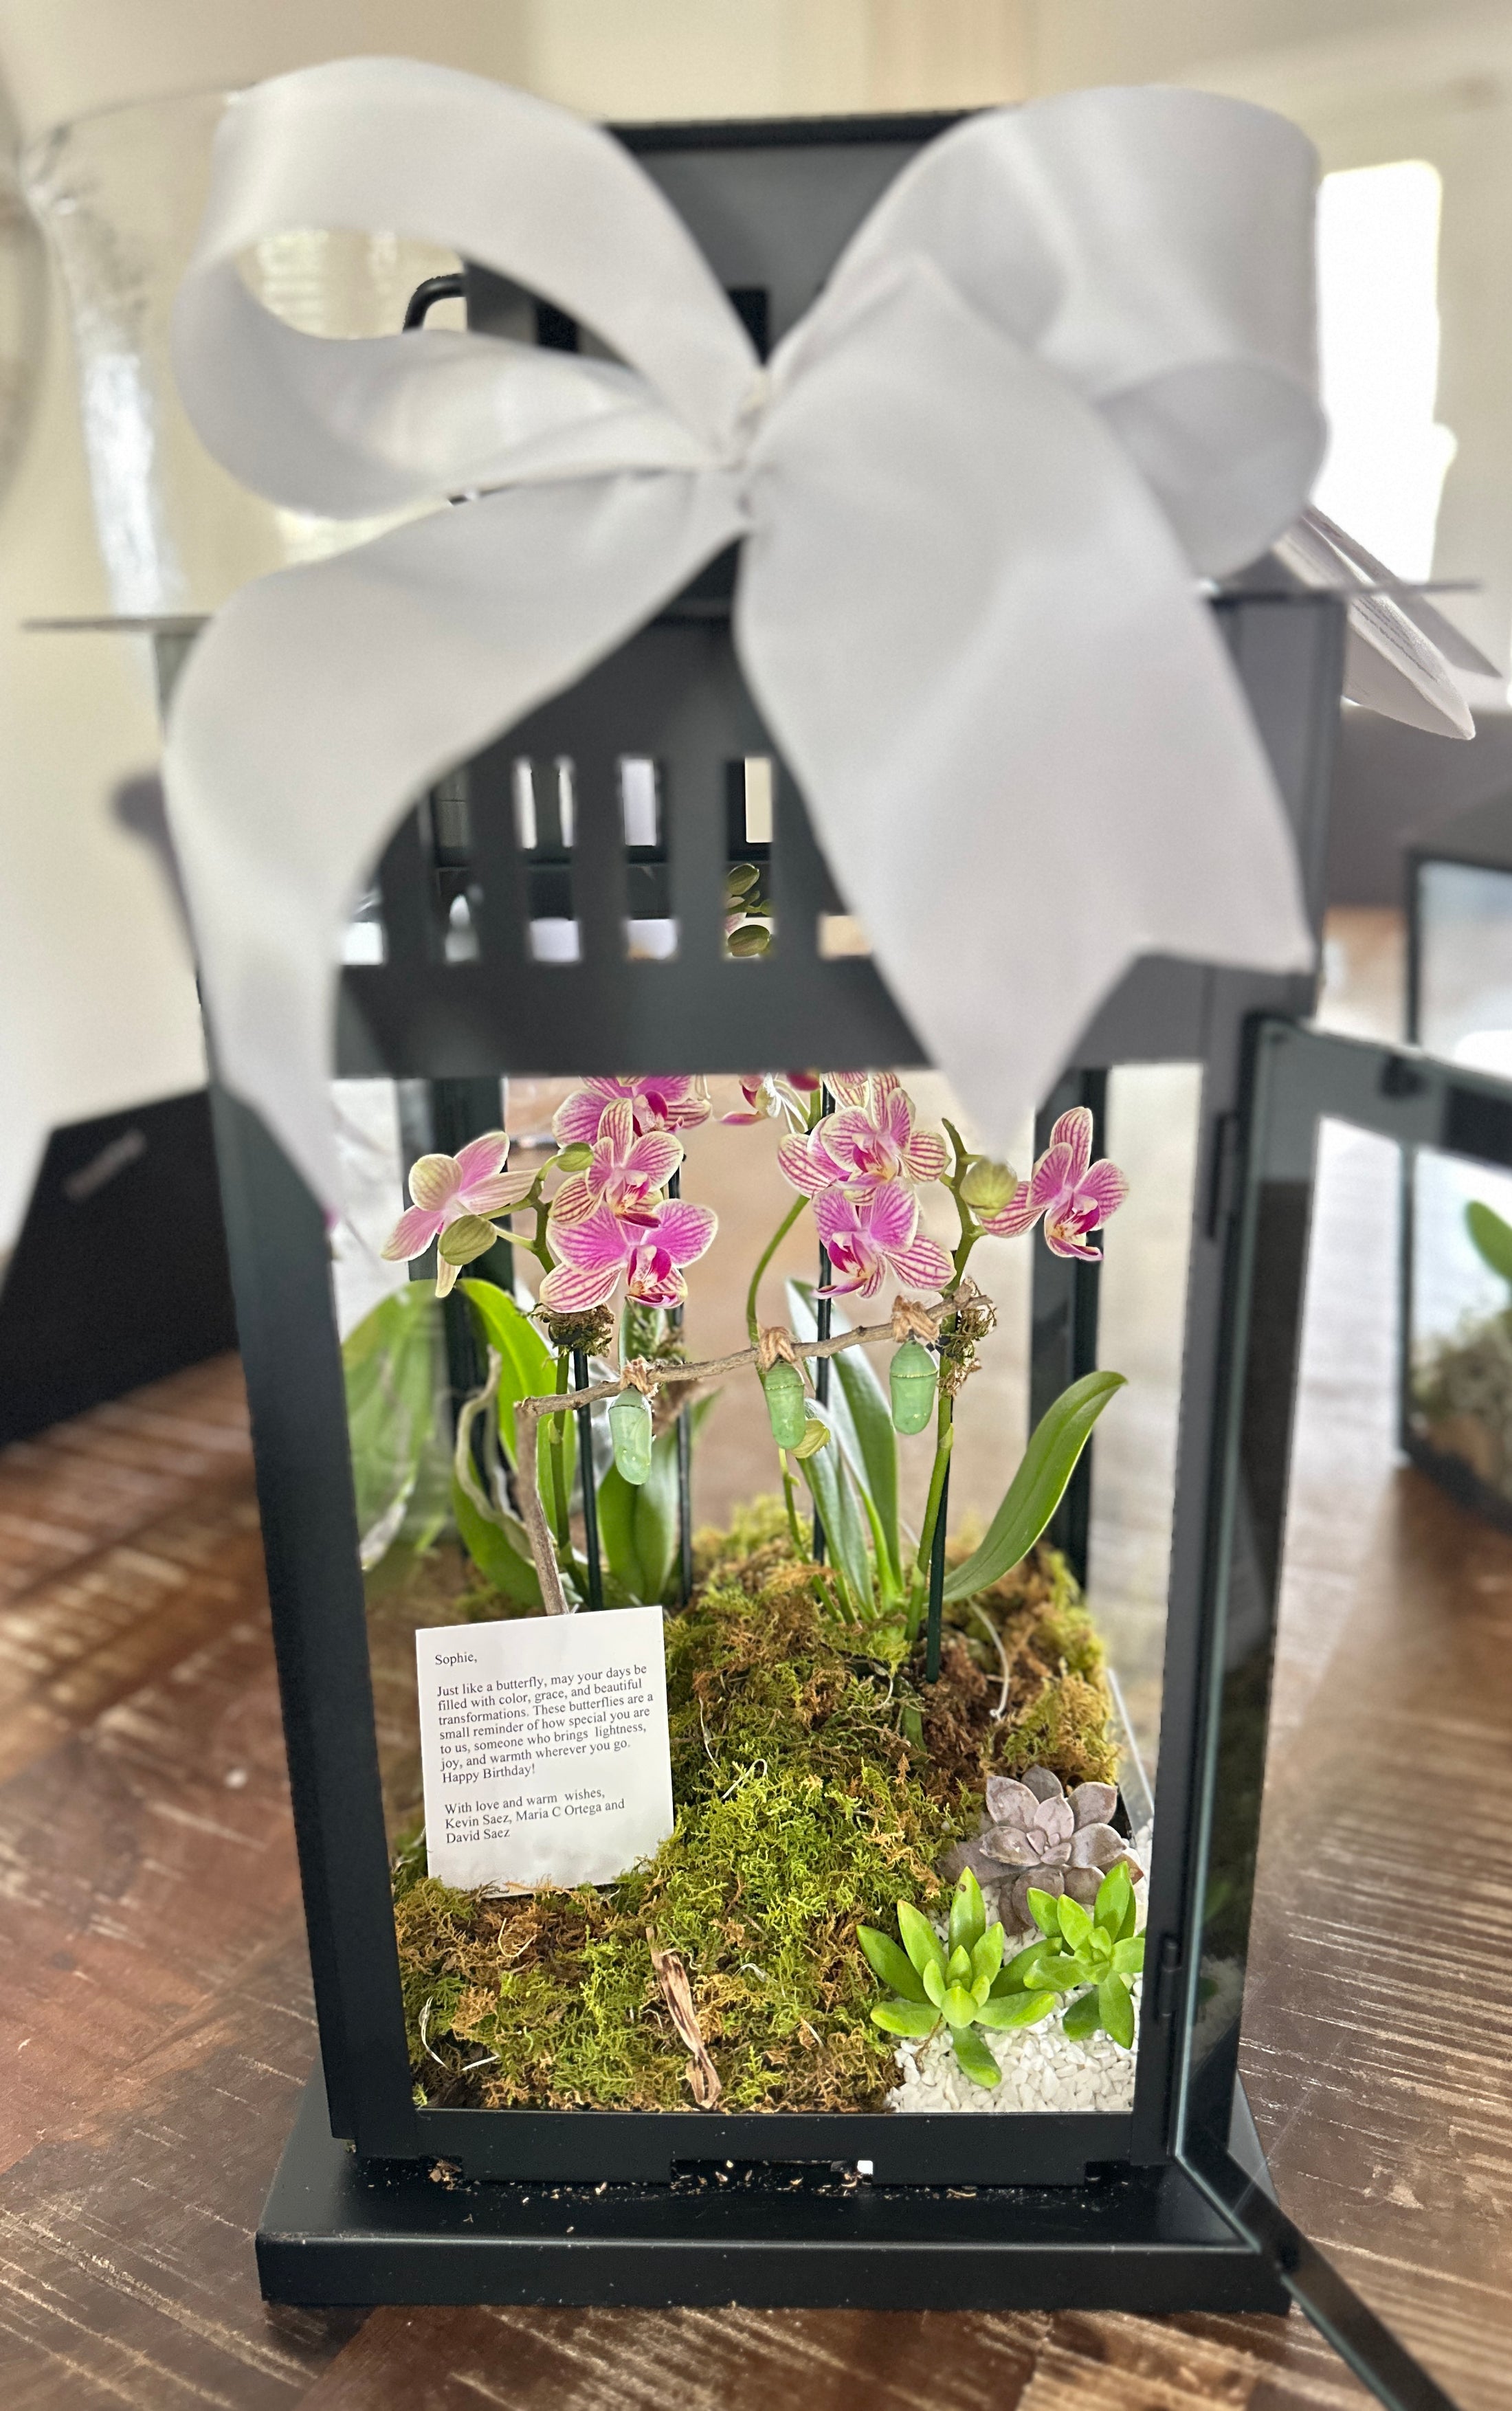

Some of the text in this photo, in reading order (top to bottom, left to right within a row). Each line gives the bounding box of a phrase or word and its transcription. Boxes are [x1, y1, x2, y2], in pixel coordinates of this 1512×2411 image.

[435, 1652, 477, 1667] Sophie,
[437, 1686, 459, 1697] Just
[463, 1683, 483, 1694] like
[496, 1676, 547, 1691] butterfly,
[551, 1675, 574, 1686] may
[577, 1671, 603, 1685] your
[606, 1667, 631, 1679] days
[634, 1664, 647, 1675] be
[438, 1678, 642, 1711] filled with color, grace, and beautiful
[438, 1709, 529, 1726] transformations.
[533, 1704, 566, 1715] These
[569, 1697, 624, 1711] butterflies
[627, 1695, 644, 1704] are
[440, 1709, 649, 1740] small reminder of how special you are
[440, 1724, 646, 1754] to us, someone who brings lightness,
[440, 1740, 630, 1772] joy, and warmth wherever you go.
[443, 1763, 535, 1785] Happy Birthday!
[445, 1788, 605, 1814] With love and warm wishes,
[445, 1798, 625, 1829] Kevin Saez, Maria C Ortega and
[447, 1829, 510, 1843] David Saez
